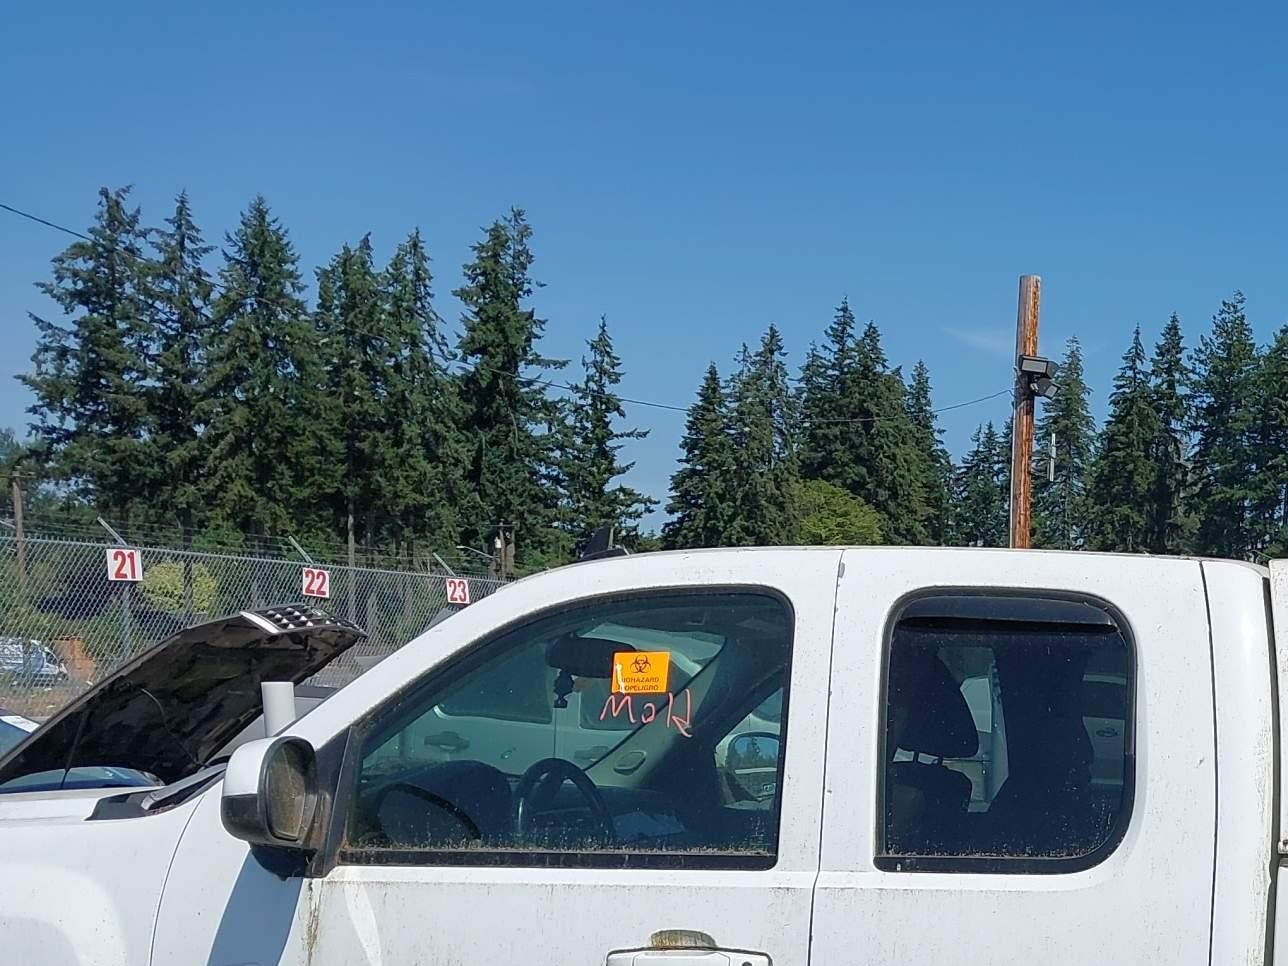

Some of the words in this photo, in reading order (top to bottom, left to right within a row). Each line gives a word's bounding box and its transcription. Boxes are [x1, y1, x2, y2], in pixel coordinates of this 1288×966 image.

[113, 550, 137, 579] 21
[304, 569, 327, 596] 22
[448, 579, 467, 602] 23
[617, 684, 660, 692] OPELIGRO
[621, 676, 660, 684] IOHAZARD
